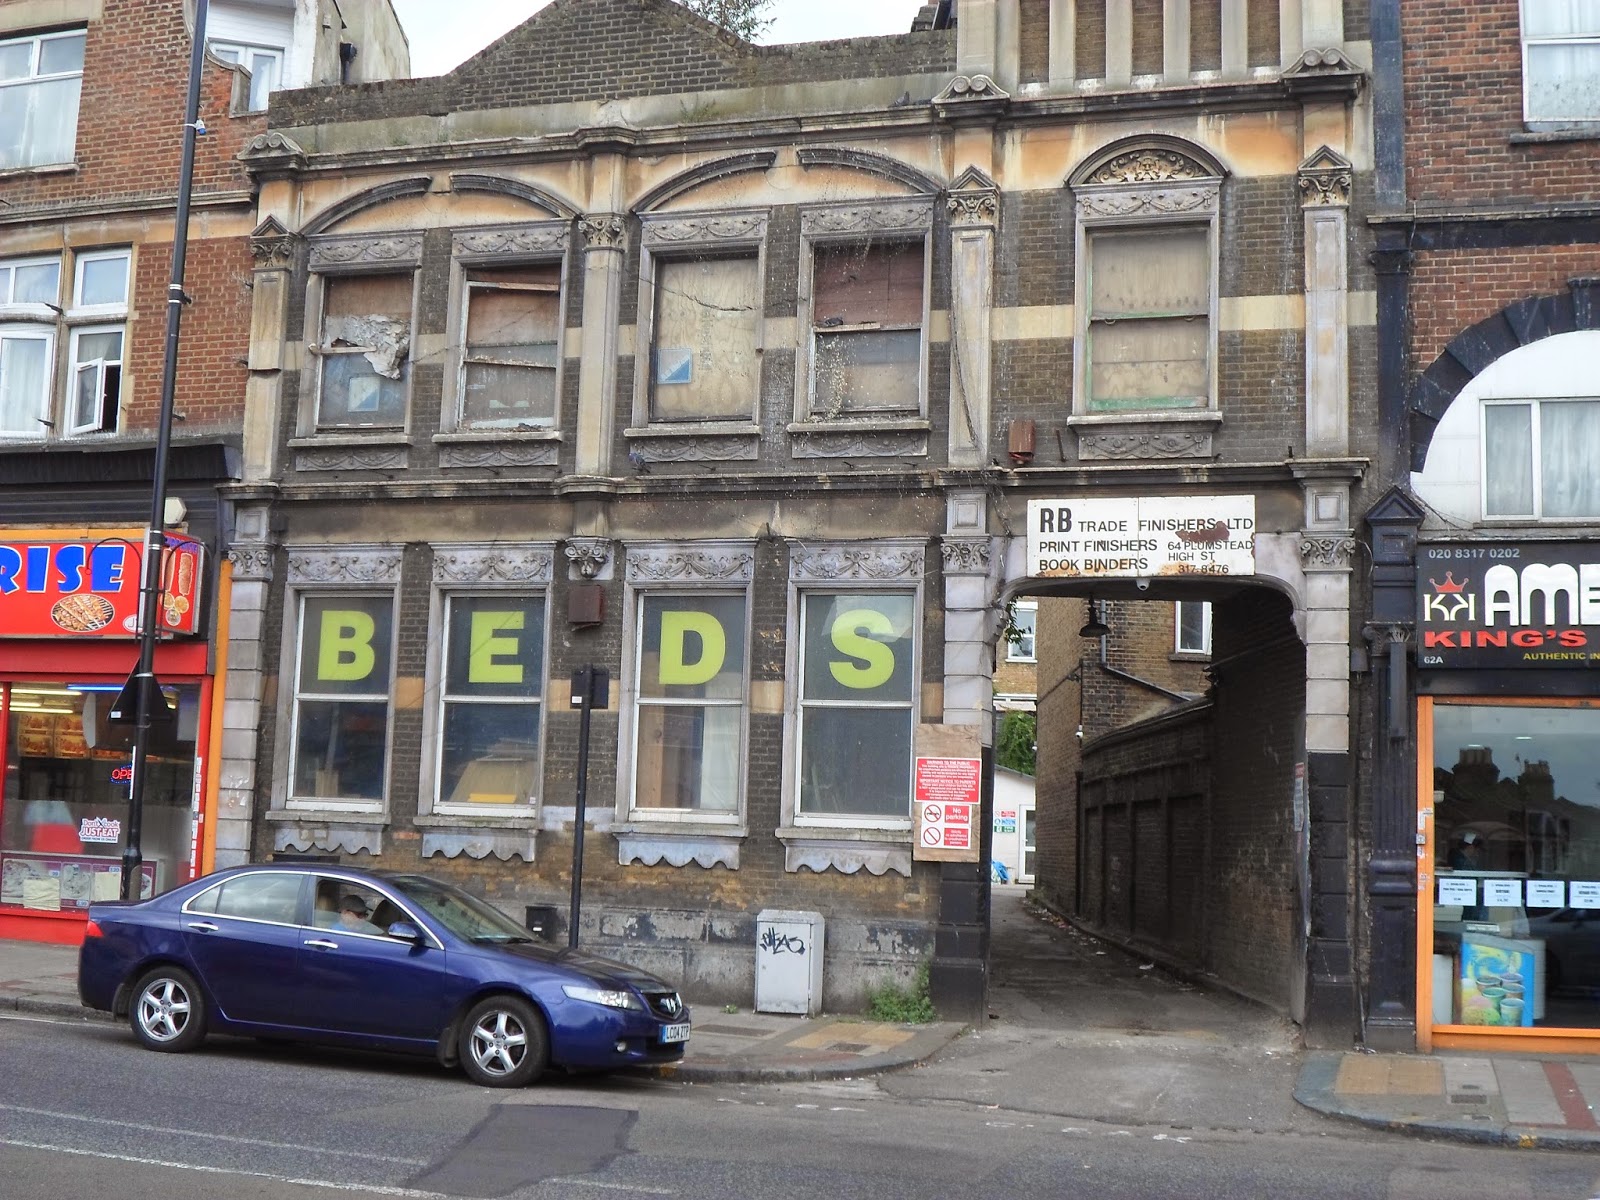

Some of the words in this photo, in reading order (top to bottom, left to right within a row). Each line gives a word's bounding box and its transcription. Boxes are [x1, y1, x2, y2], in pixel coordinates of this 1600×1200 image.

[1040, 507, 1072, 533] RB
[1078, 520, 1128, 532] TRADE
[1139, 517, 1216, 531] FINISHERS
[1227, 518, 1254, 530] LTD
[1039, 541, 1080, 553] PRINT
[1084, 539, 1158, 552] FINISHERS
[1167, 541, 1182, 551] 64
[1184, 540, 1254, 551] PLUMSTEAD
[1168, 552, 1194, 561] HIGH
[1200, 551, 1216, 561] ST
[1428, 549, 1451, 559] 020
[1455, 549, 1486, 559] 8317
[1489, 548, 1520, 559] 0202
[1039, 559, 1079, 571] BOOK
[1084, 557, 1149, 571] BINDERS
[1424, 629, 1588, 648] KING'S
[1423, 656, 1444, 664] 62A
[1523, 652, 1586, 660] AUTHENTIC
[81, 826, 102, 836] JUST
[102, 827, 118, 837] EAT
